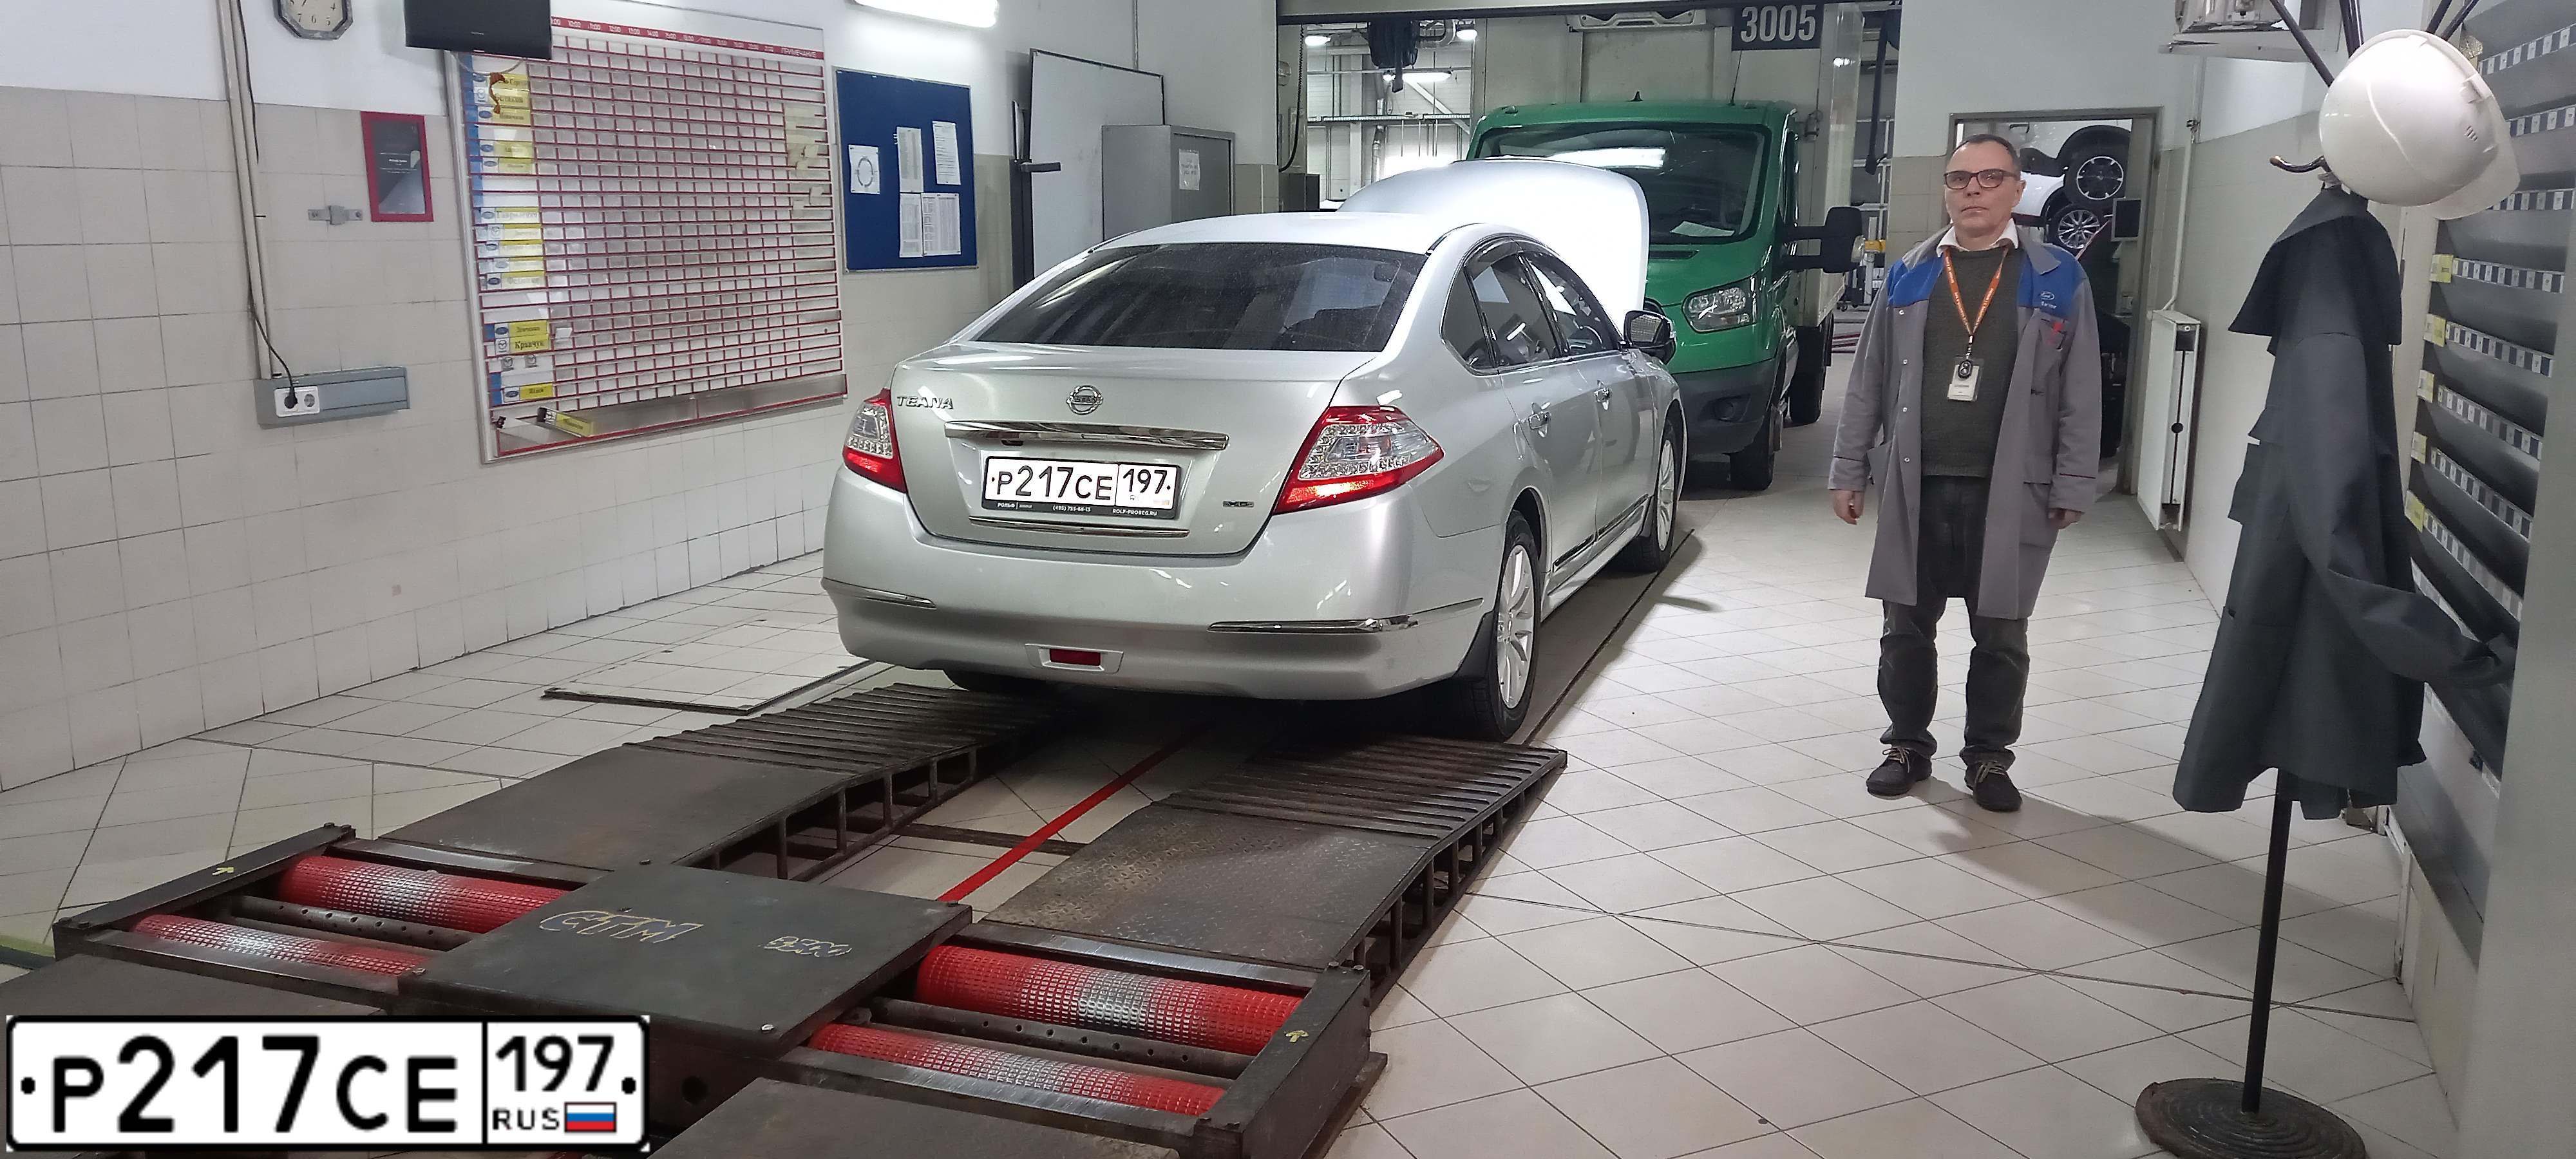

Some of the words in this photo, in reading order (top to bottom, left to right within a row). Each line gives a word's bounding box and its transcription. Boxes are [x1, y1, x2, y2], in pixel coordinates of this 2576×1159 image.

[298, 13, 302, 23] 7
[311, 15, 317, 24] 6
[1740, 5, 1817, 43] 3005
[896, 395, 954, 410] TEANA
[1122, 468, 1168, 494] 197
